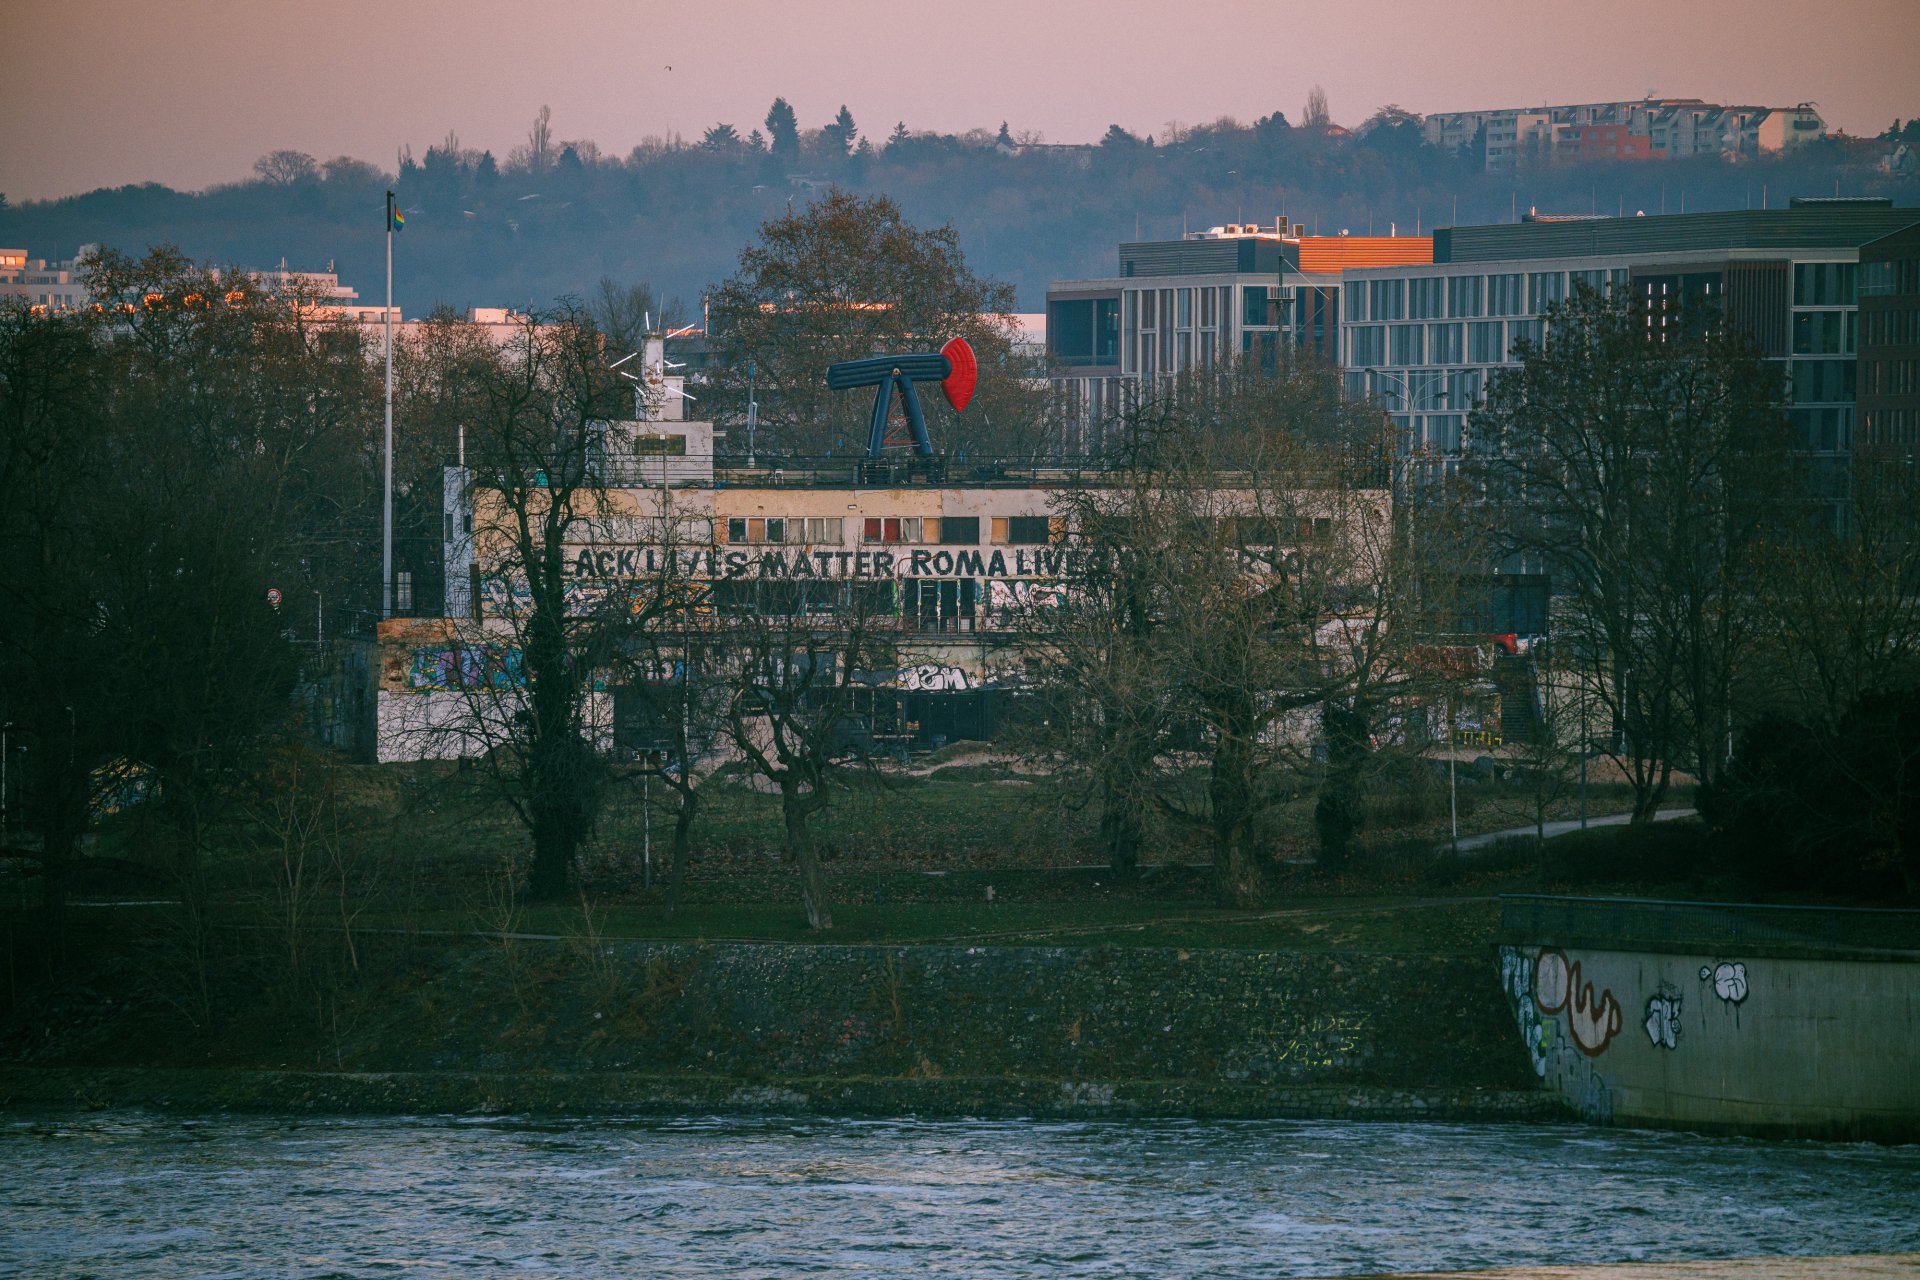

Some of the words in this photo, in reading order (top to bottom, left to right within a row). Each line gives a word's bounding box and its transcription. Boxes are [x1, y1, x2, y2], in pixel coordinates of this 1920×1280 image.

[646, 548, 748, 578] LIVES
[758, 551, 894, 578] MATTER
[911, 549, 1008, 576] ROMA
